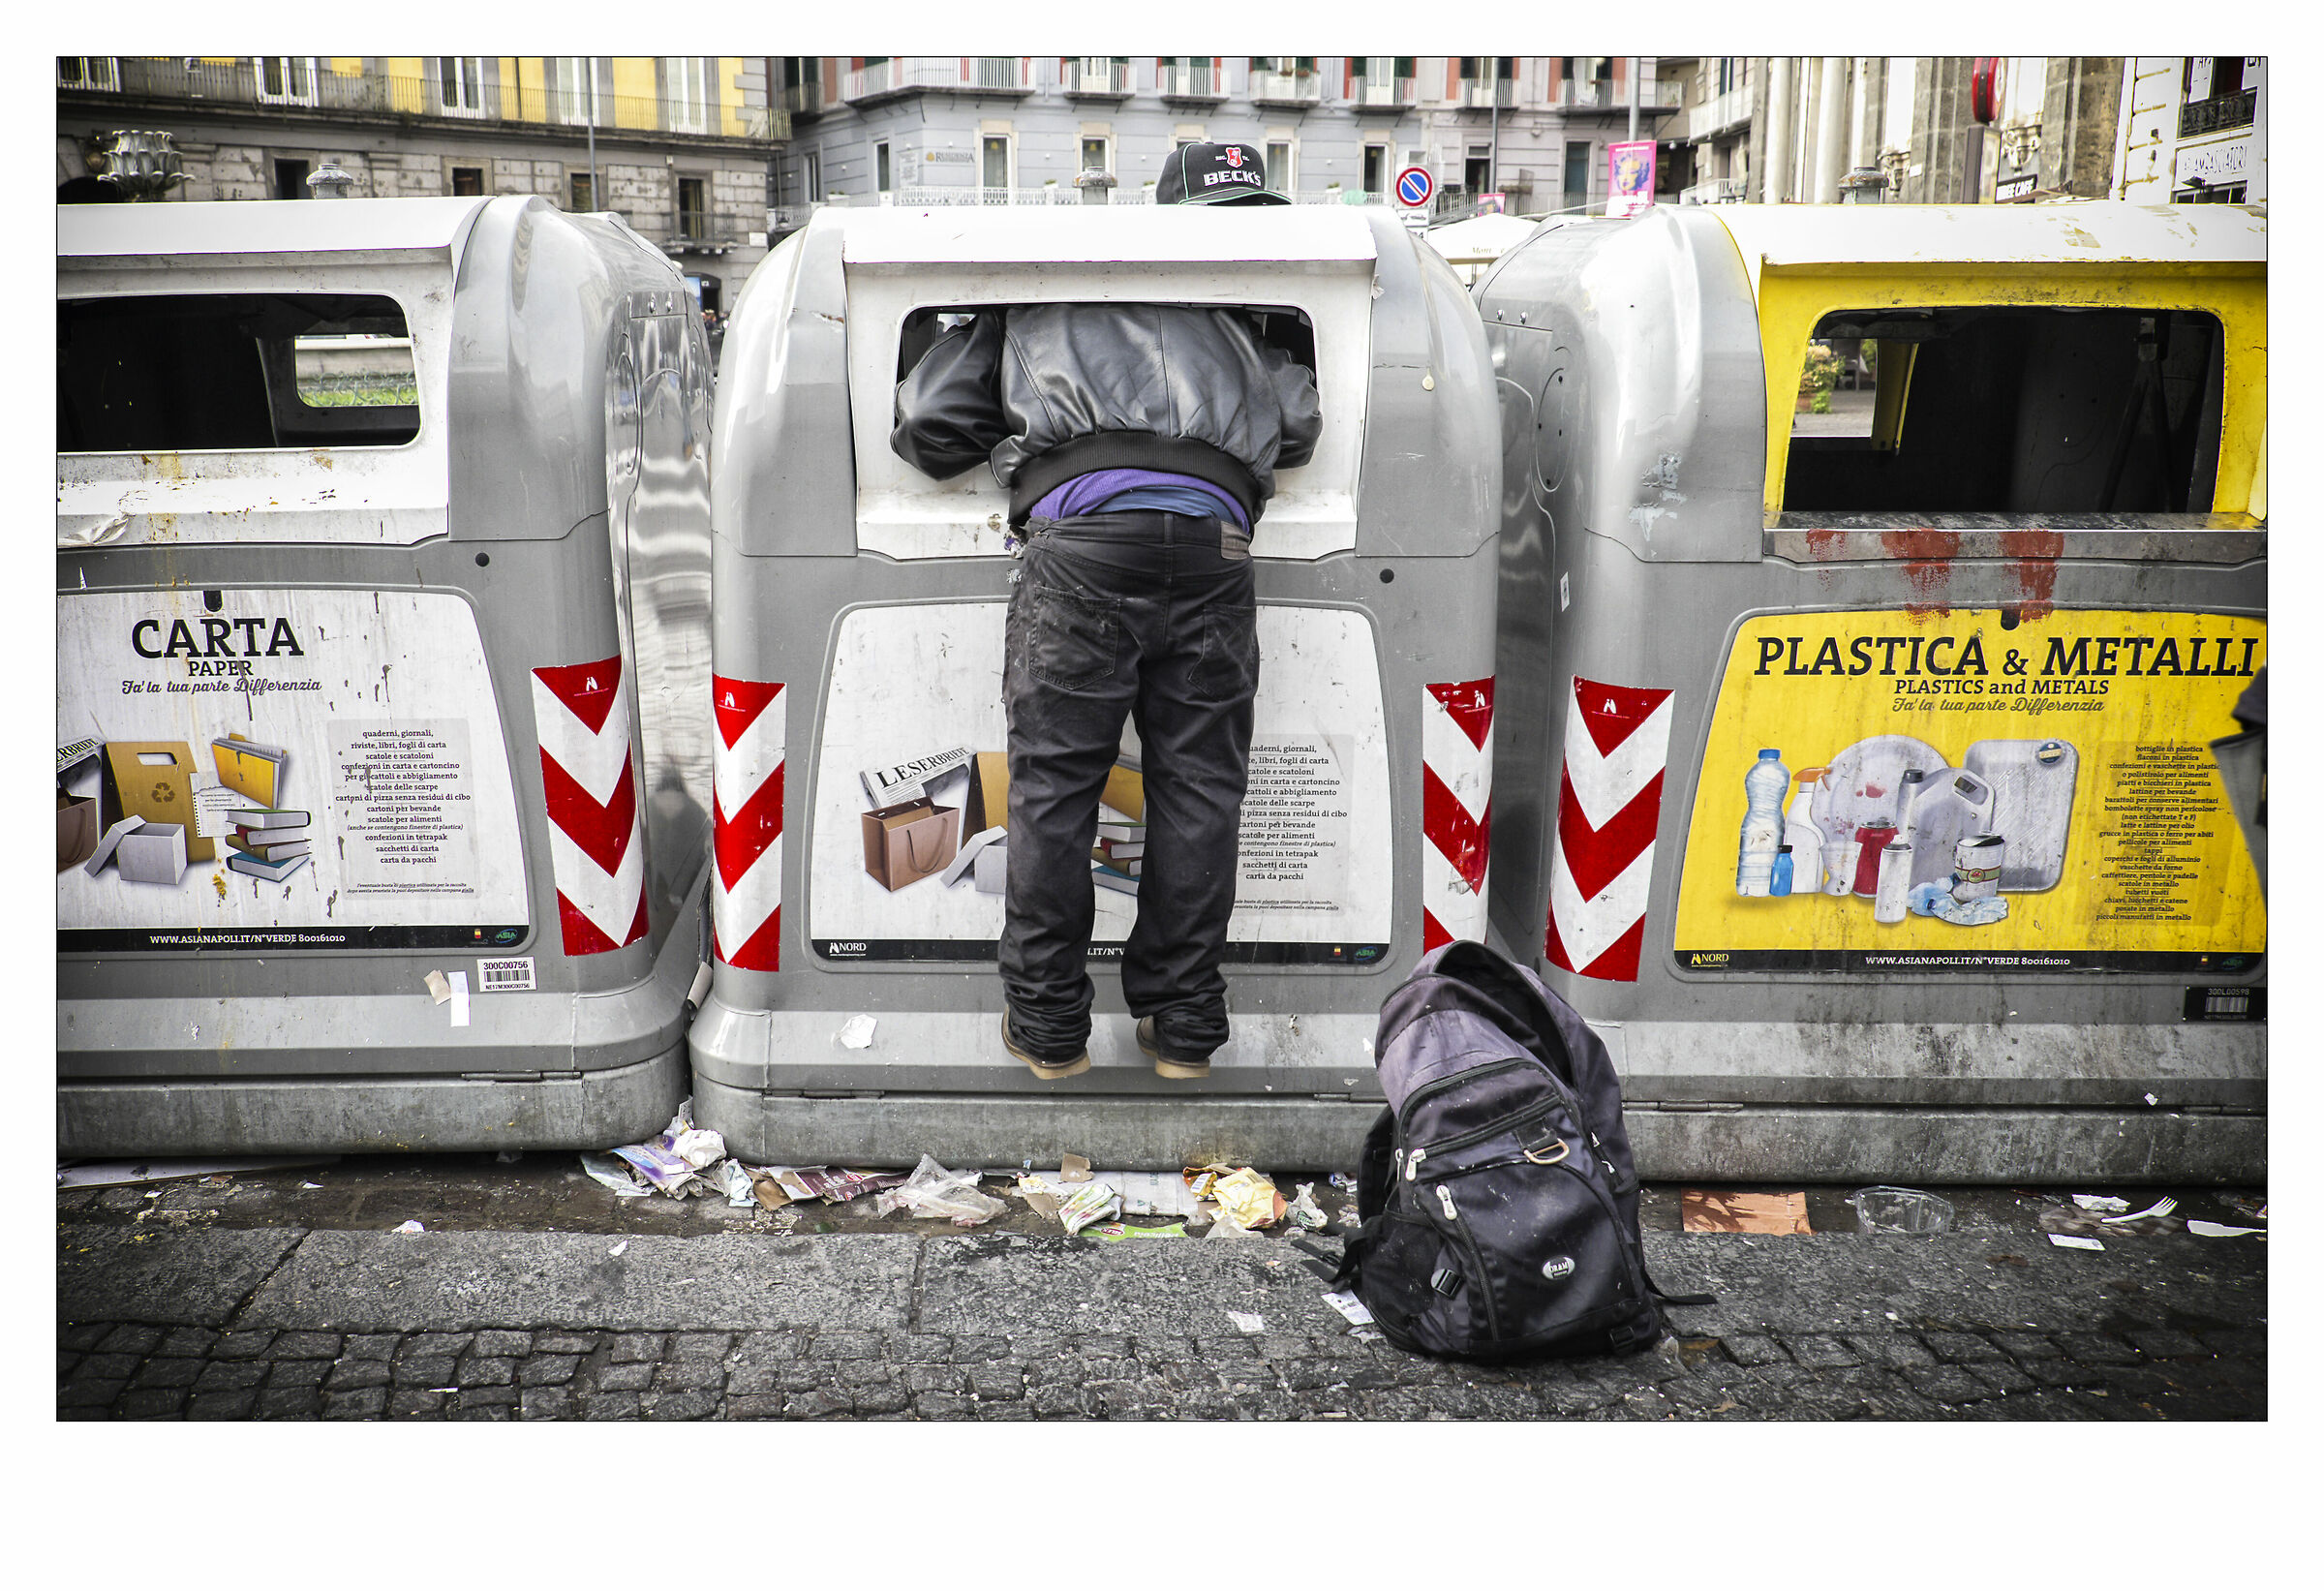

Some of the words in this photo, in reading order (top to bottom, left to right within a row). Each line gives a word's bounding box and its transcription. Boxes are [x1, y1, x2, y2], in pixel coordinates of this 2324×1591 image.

[1203, 170, 1261, 186] BECK'S
[132, 618, 304, 658] CARTA
[1754, 636, 1989, 677] PLASTICA
[2003, 649, 2029, 675] &
[2042, 636, 2259, 677] METALLI
[189, 660, 254, 676] PAPER
[147, 681, 162, 692] la
[167, 682, 190, 692] tua
[192, 680, 230, 694] parte
[234, 678, 321, 695] Differenzia
[1894, 680, 1983, 693] PLASTICS
[1989, 679, 2026, 693] and
[2031, 680, 2109, 694] METALS
[1919, 698, 1934, 711] la
[1940, 699, 1965, 710] tua
[1965, 698, 2007, 713] parte
[2010, 697, 2104, 715] Differenzia
[359, 773, 395, 781] gicattoli
[299, 933, 345, 942] 800161010
[839, 942, 867, 952] NORD
[2021, 957, 2070, 965] 800161010
